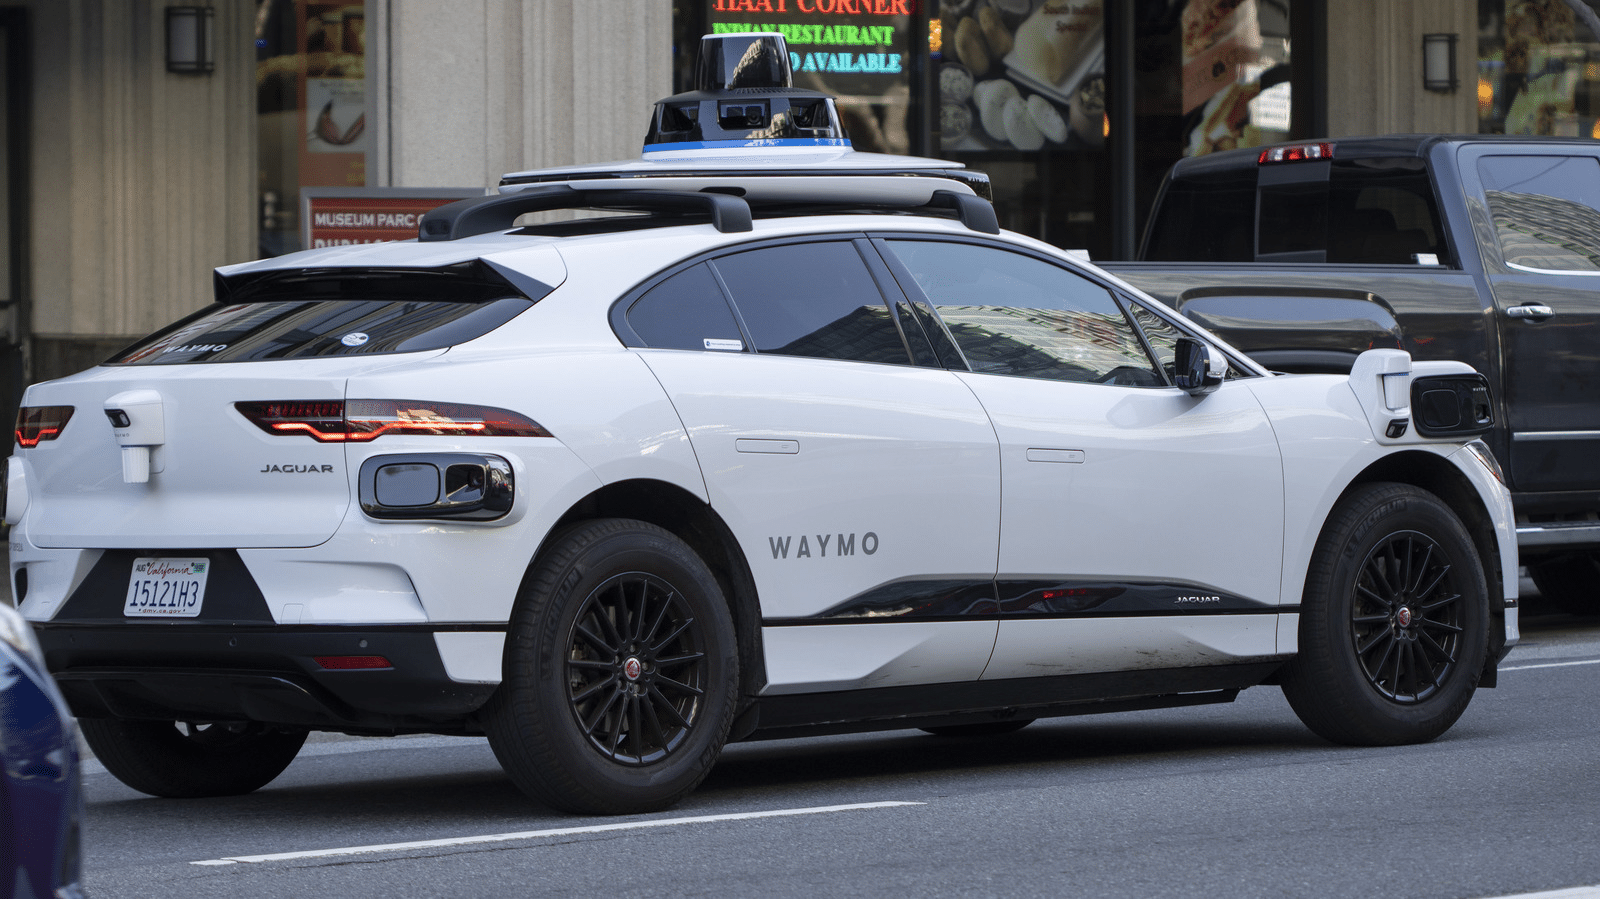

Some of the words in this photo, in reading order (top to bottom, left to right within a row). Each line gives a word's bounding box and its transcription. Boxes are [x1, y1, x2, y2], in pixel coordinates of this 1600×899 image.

[712, 0, 787, 13] HAAT
[797, 0, 910, 15] CORNER
[778, 25, 895, 45] RESTAURANT
[802, 52, 902, 73] AVAILABLE
[314, 213, 375, 226] MUSEUM
[377, 214, 415, 227] PARC
[162, 344, 228, 354] WAYMO
[260, 464, 334, 473] JAGUAR
[768, 531, 879, 559] WAYMO
[136, 564, 146, 572] AUG
[147, 562, 193, 579] California
[130, 580, 199, 607] 15121H3
[1173, 596, 1220, 604] JAGUAR
